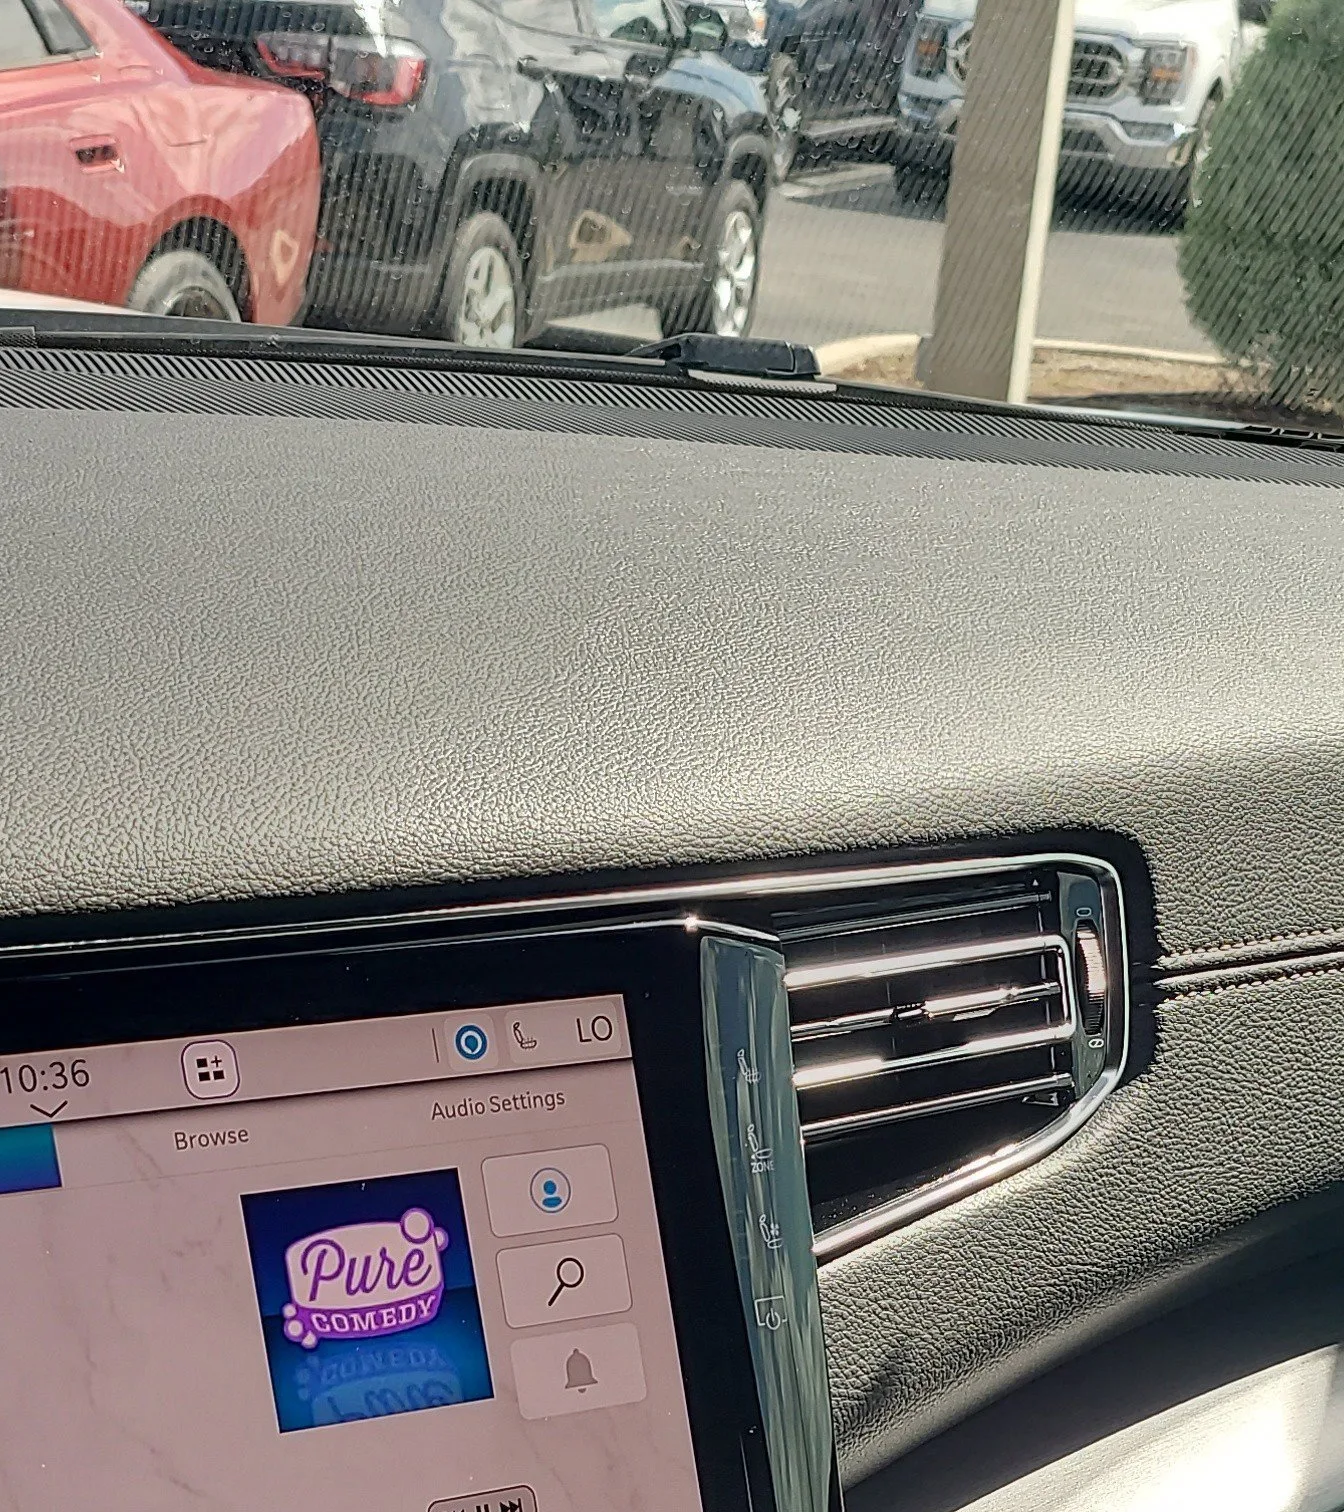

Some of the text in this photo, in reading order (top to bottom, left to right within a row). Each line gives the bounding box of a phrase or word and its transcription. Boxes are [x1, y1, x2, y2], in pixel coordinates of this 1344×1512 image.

[575, 1015, 613, 1044] LO
[0, 1058, 91, 1096] 10:36
[430, 1089, 566, 1121] Audio Settings
[173, 1125, 250, 1151] Browse
[751, 1161, 775, 1173] ZONE
[300, 1237, 433, 1303] Pure
[310, 1295, 437, 1335] COMEDY
